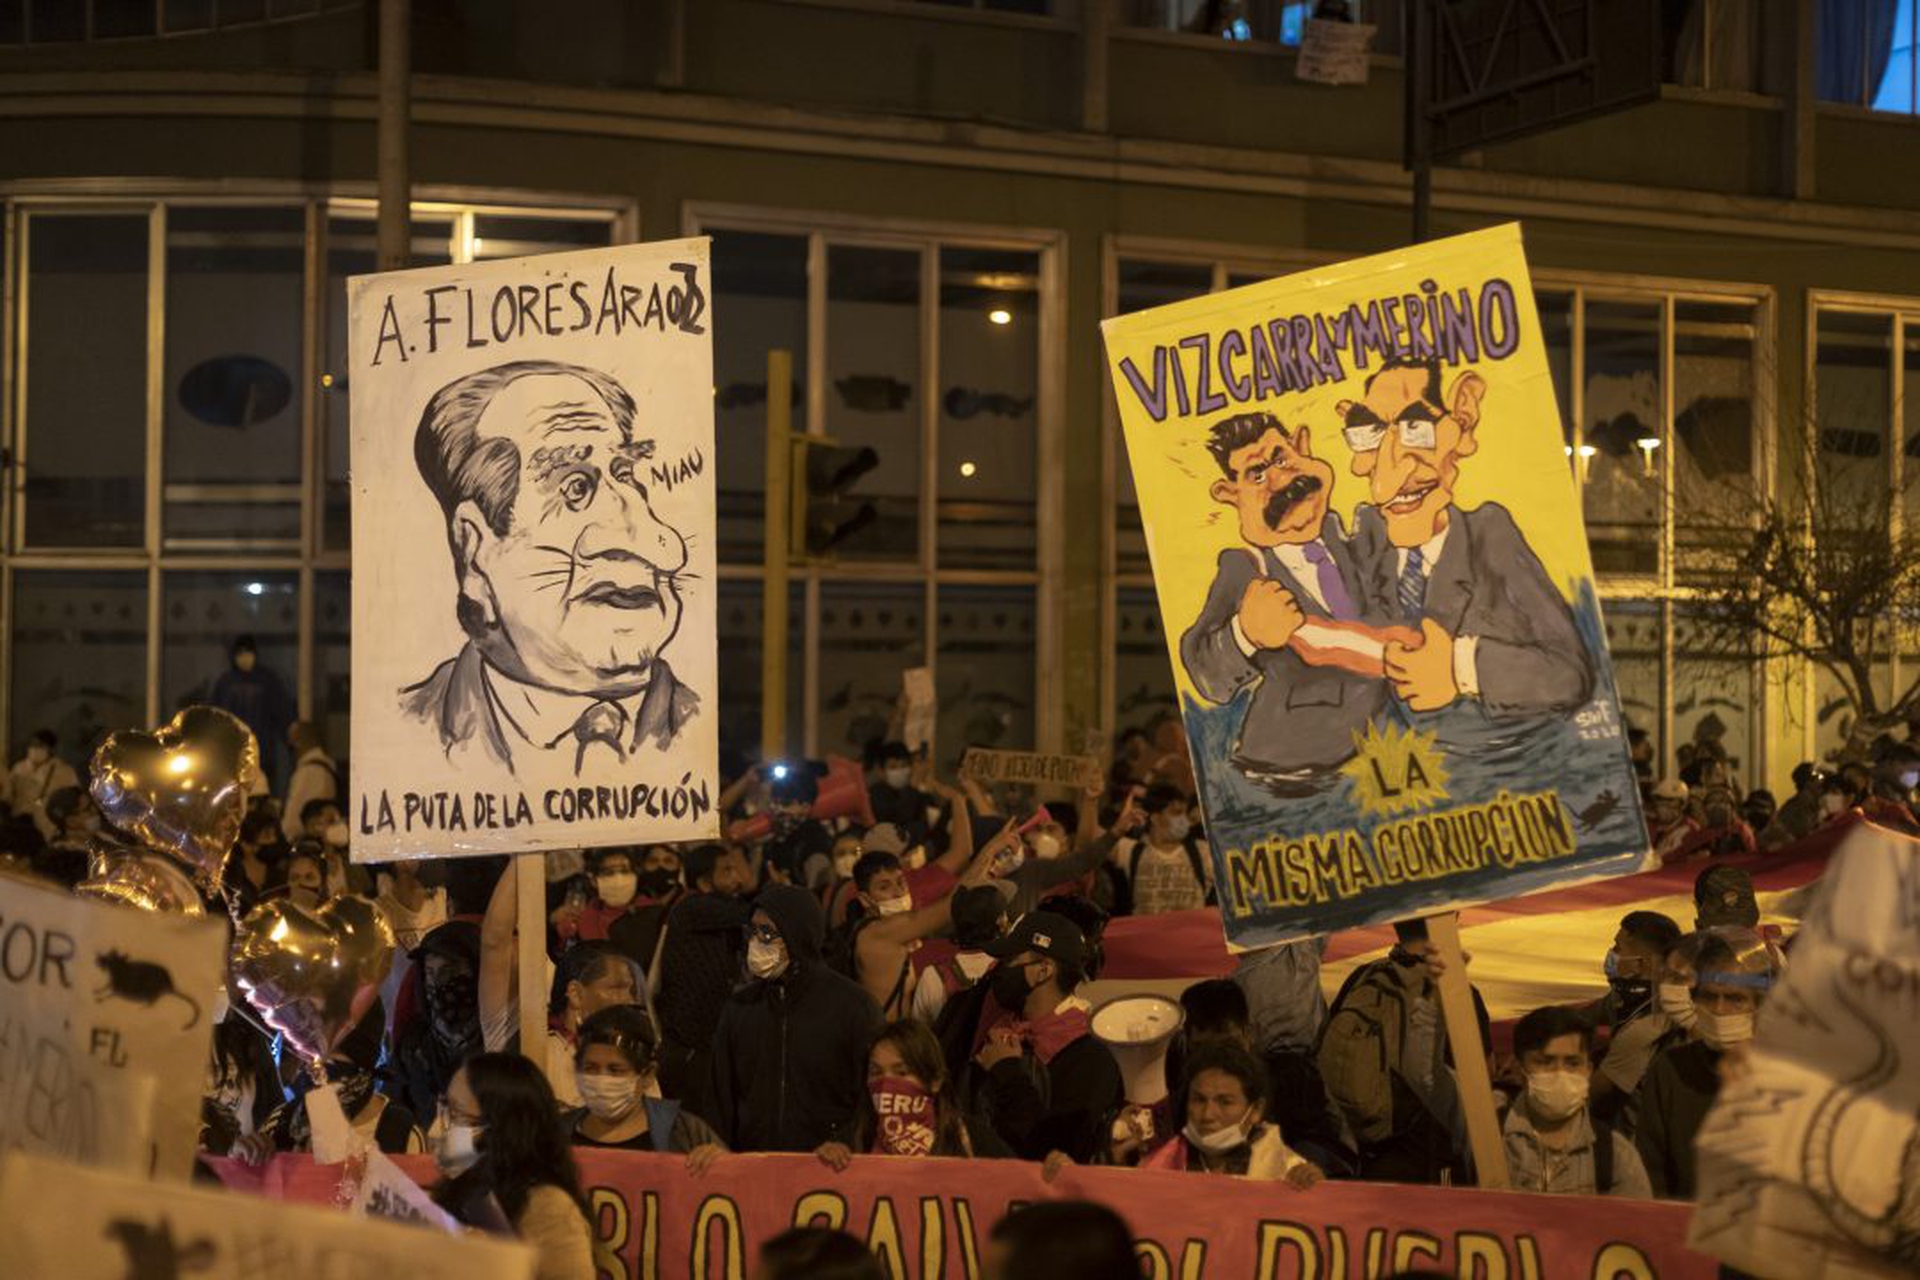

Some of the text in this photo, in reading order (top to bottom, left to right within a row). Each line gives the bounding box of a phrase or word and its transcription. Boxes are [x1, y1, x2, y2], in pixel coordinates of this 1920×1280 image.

[1119, 312, 1345, 423] VIZCARRA
[1347, 278, 1521, 370] MERINO
[651, 446, 704, 493] MIAU
[360, 790, 396, 835] LA
[403, 789, 467, 833] PUTA
[543, 770, 711, 823] CORRUPCIÓN
[1370, 752, 1431, 797] LA
[1230, 837, 1373, 910] MISMA
[0, 920, 75, 989] OR
